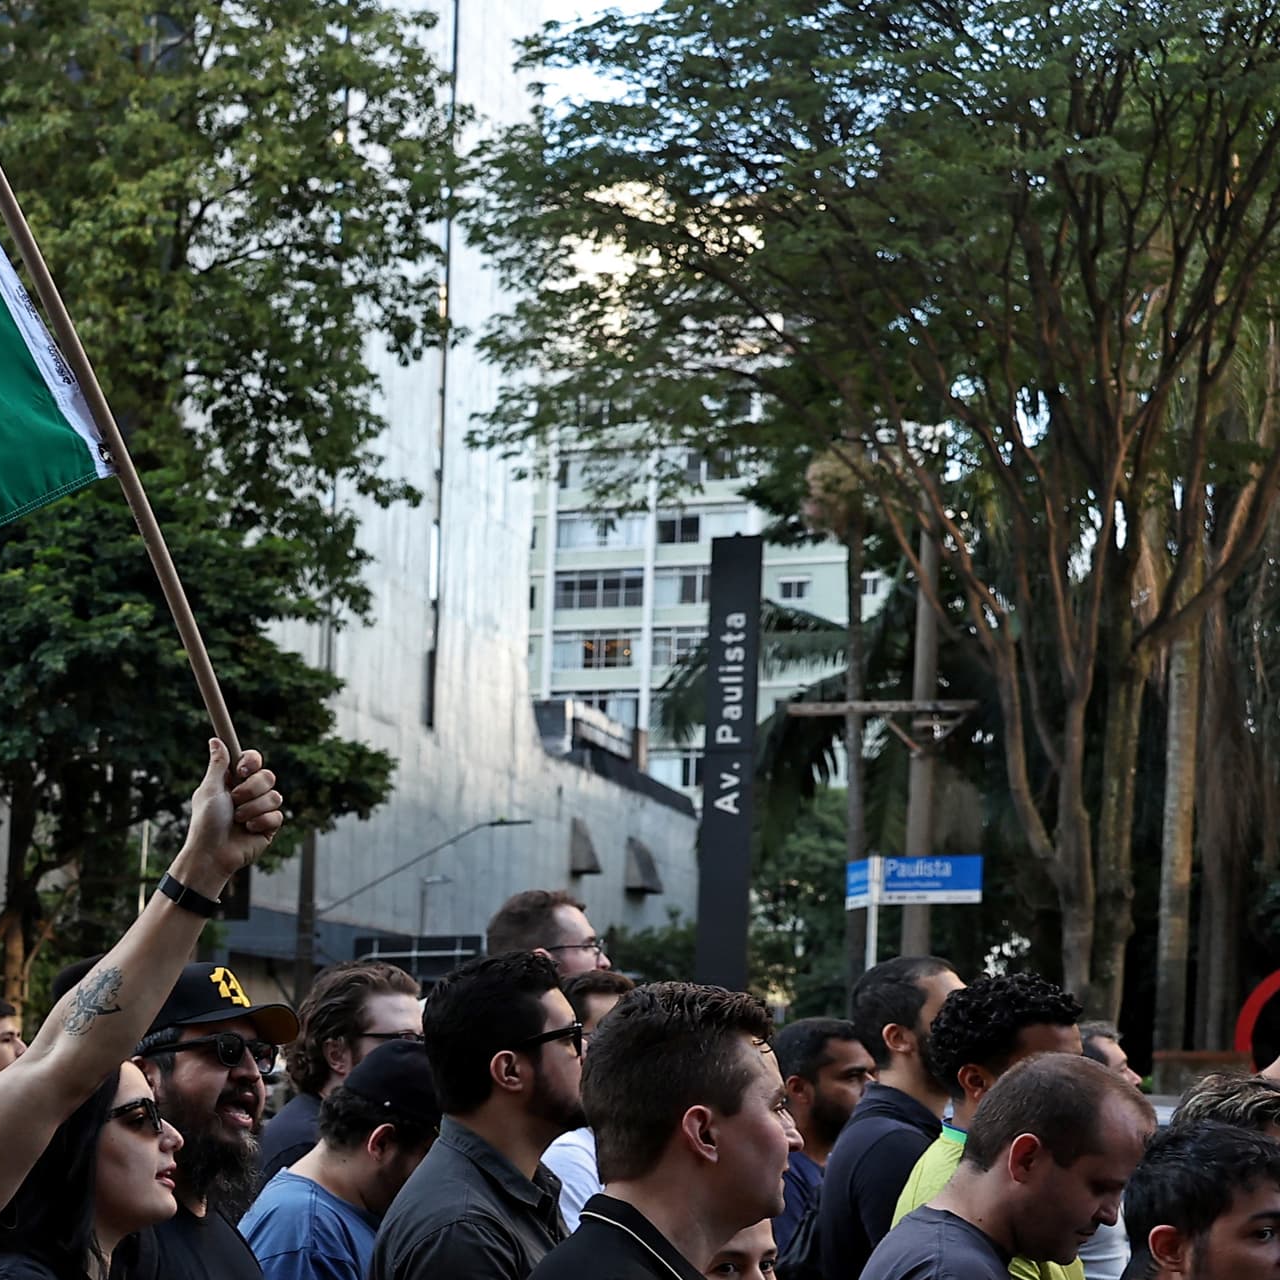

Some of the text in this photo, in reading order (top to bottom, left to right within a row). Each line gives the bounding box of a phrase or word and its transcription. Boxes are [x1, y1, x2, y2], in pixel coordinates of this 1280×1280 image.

[714, 612, 746, 815] Av. Paulista
[886, 859, 952, 878] Paulista
